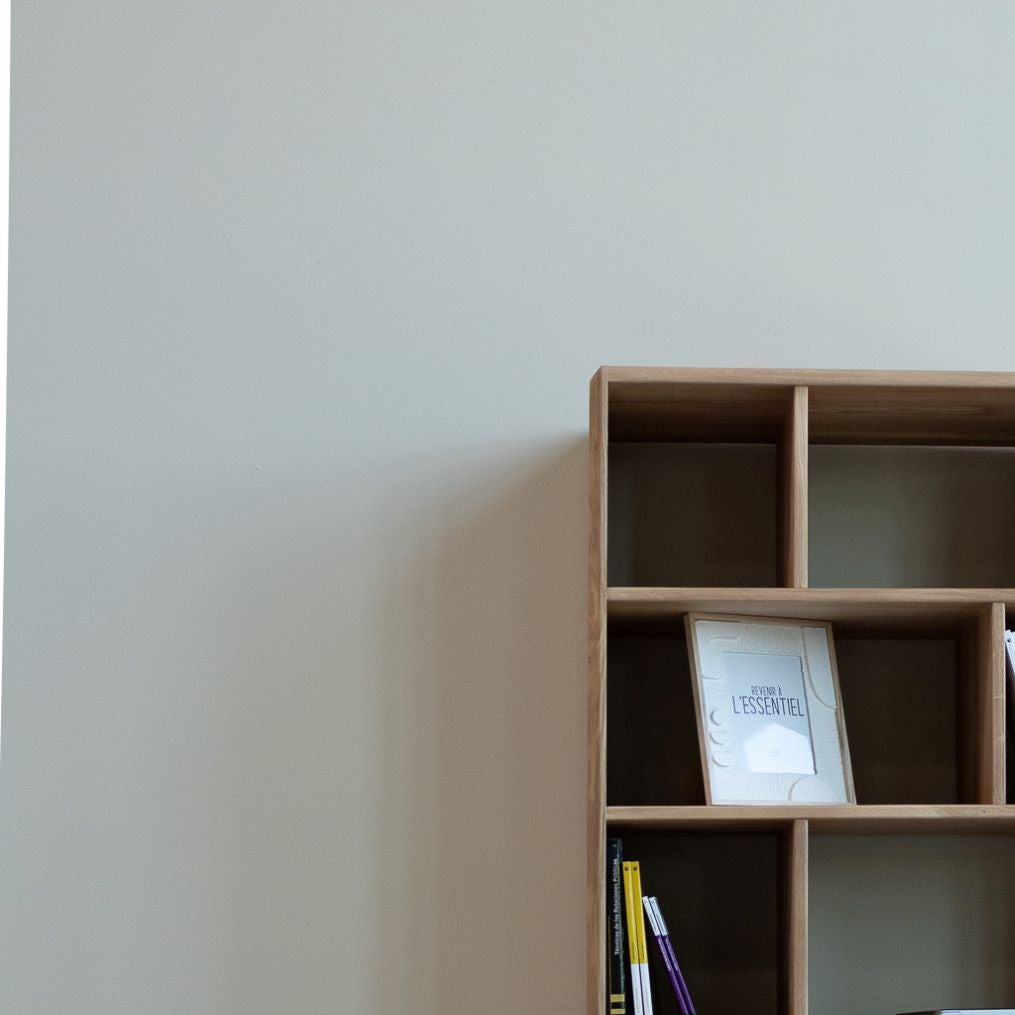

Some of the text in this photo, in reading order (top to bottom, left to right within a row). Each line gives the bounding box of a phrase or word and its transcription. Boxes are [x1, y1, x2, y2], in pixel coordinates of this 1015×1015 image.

[751, 684, 783, 696] REVENIR À
[732, 696, 805, 716] L'ESSENTIEL
